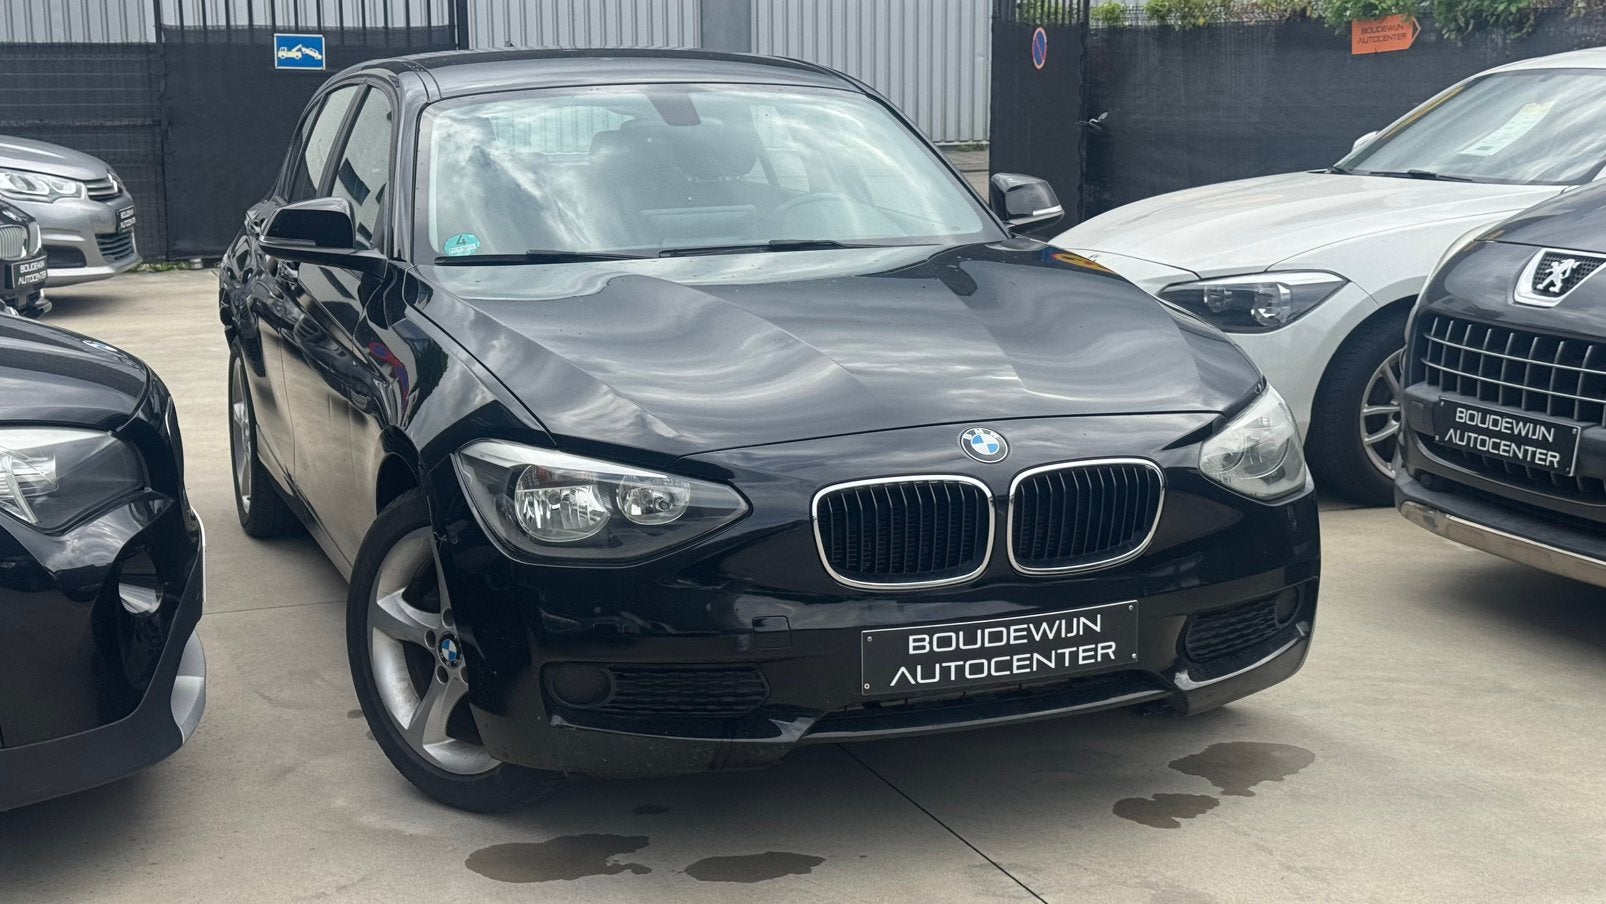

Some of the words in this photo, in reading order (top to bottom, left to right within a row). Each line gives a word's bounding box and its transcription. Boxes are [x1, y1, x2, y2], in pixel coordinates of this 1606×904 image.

[1357, 32, 1407, 44] AUTOCENTER
[456, 234, 466, 245] 4
[1455, 407, 1554, 443] BOUDEWIJN
[1444, 428, 1561, 468] AUTOCENTER
[908, 614, 1101, 654] BOUDEWIJN
[890, 641, 1117, 687] AUTOCENTER
